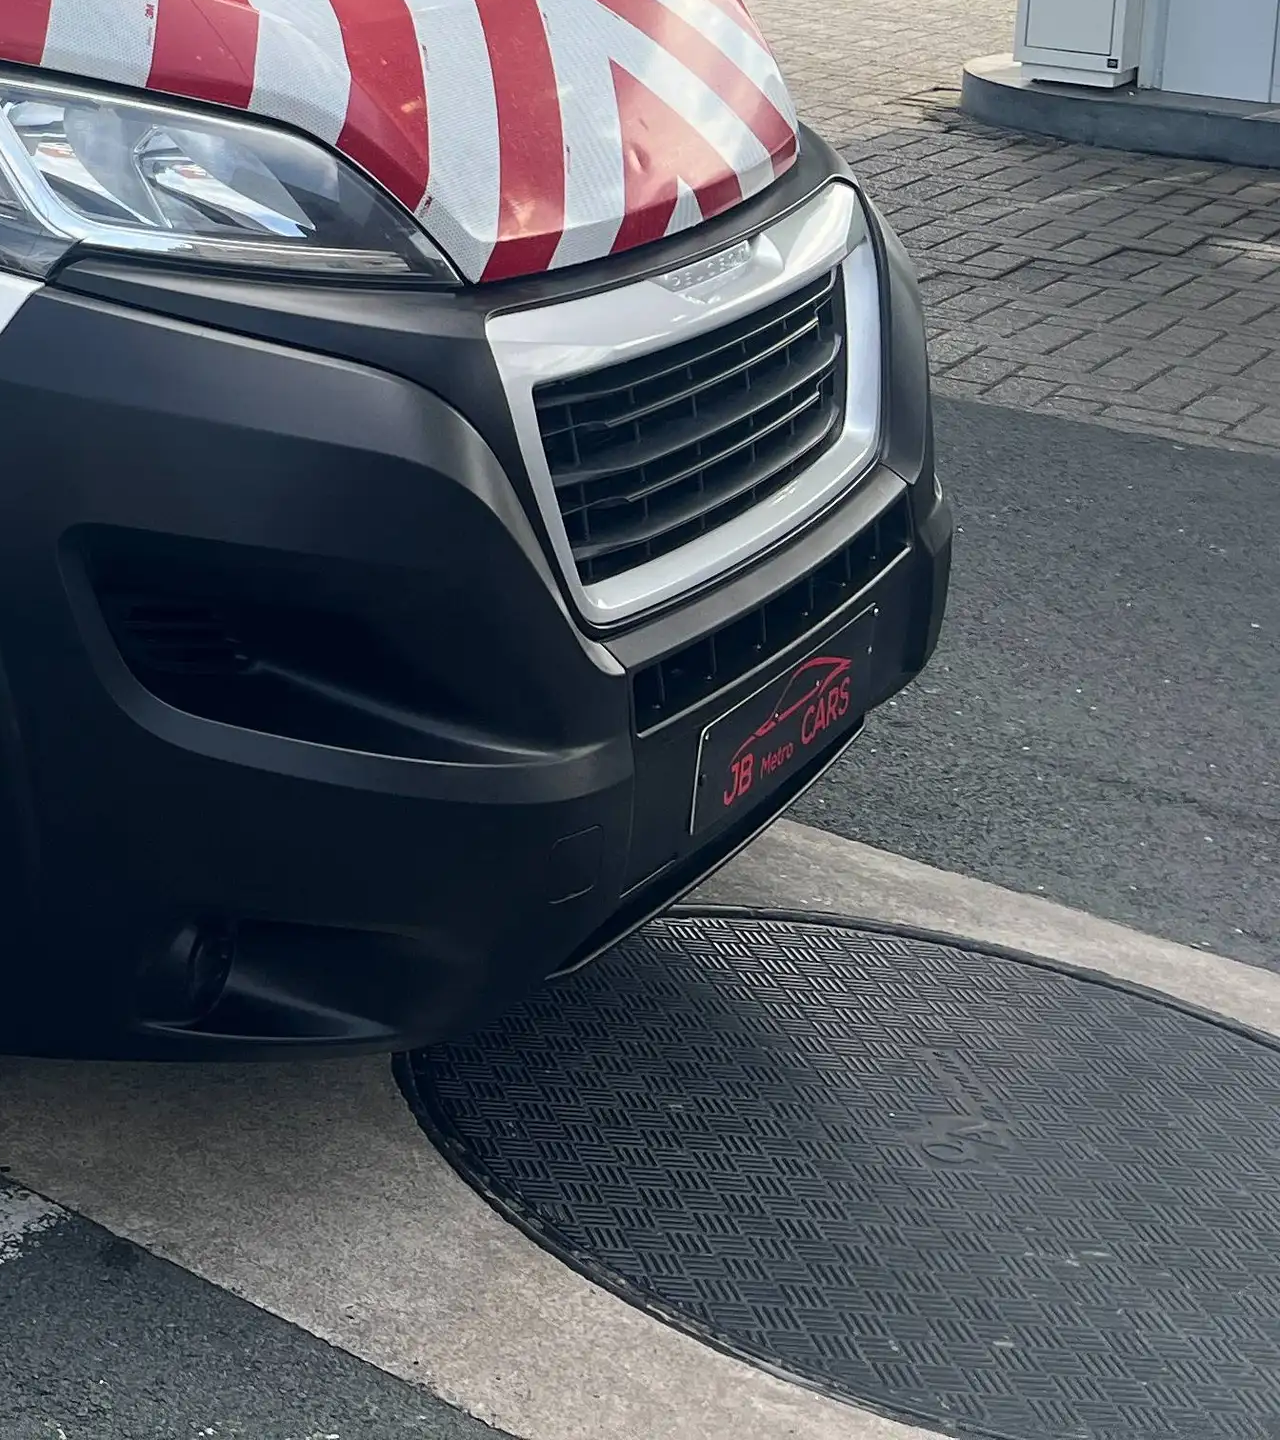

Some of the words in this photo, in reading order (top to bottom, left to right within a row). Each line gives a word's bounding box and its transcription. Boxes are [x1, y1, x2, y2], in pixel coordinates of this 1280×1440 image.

[724, 753, 754, 805] JB
[760, 742, 794, 780] Metro
[801, 676, 850, 744] CARS
